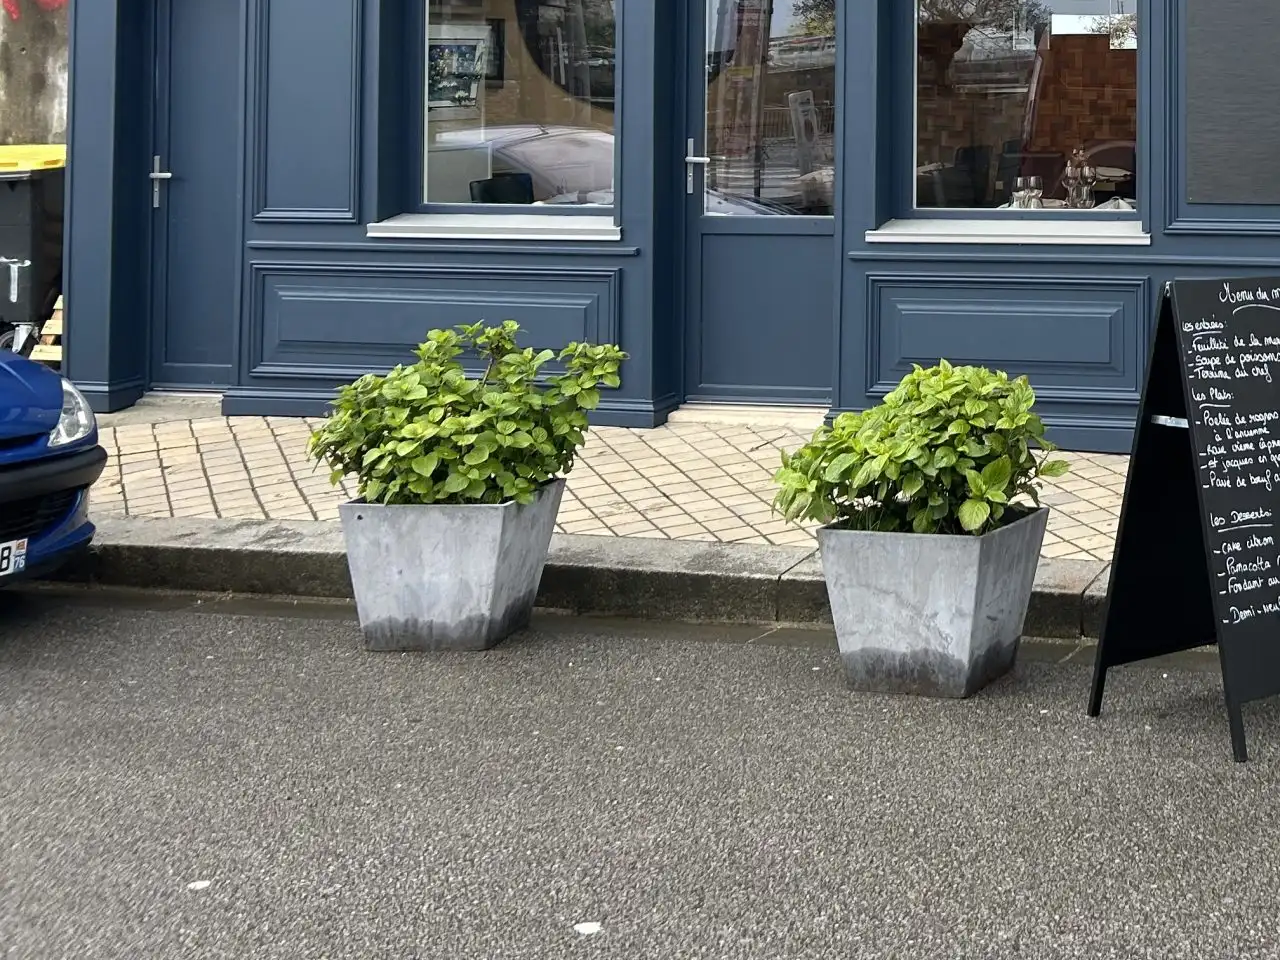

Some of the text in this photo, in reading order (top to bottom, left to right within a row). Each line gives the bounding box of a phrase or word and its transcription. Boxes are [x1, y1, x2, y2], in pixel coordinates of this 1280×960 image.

[1219, 282, 1254, 303] Menu
[1256, 287, 1270, 301] du
[1234, 335, 1246, 347] de
[1249, 333, 1262, 347] la
[1195, 354, 1221, 370] Soupe
[1224, 353, 1236, 365] de
[1193, 363, 1273, 383] Terrine du chef
[1234, 412, 1247, 425] de
[1213, 429, 1222, 442] à
[1258, 455, 1268, 464] en
[1209, 470, 1231, 488] Pavé
[1236, 476, 1247, 488] de
[1246, 534, 1274, 549] citron
[14, 555, 26, 569] 76
[1228, 577, 1263, 594] Fondant
[1268, 575, 1280, 586] au
